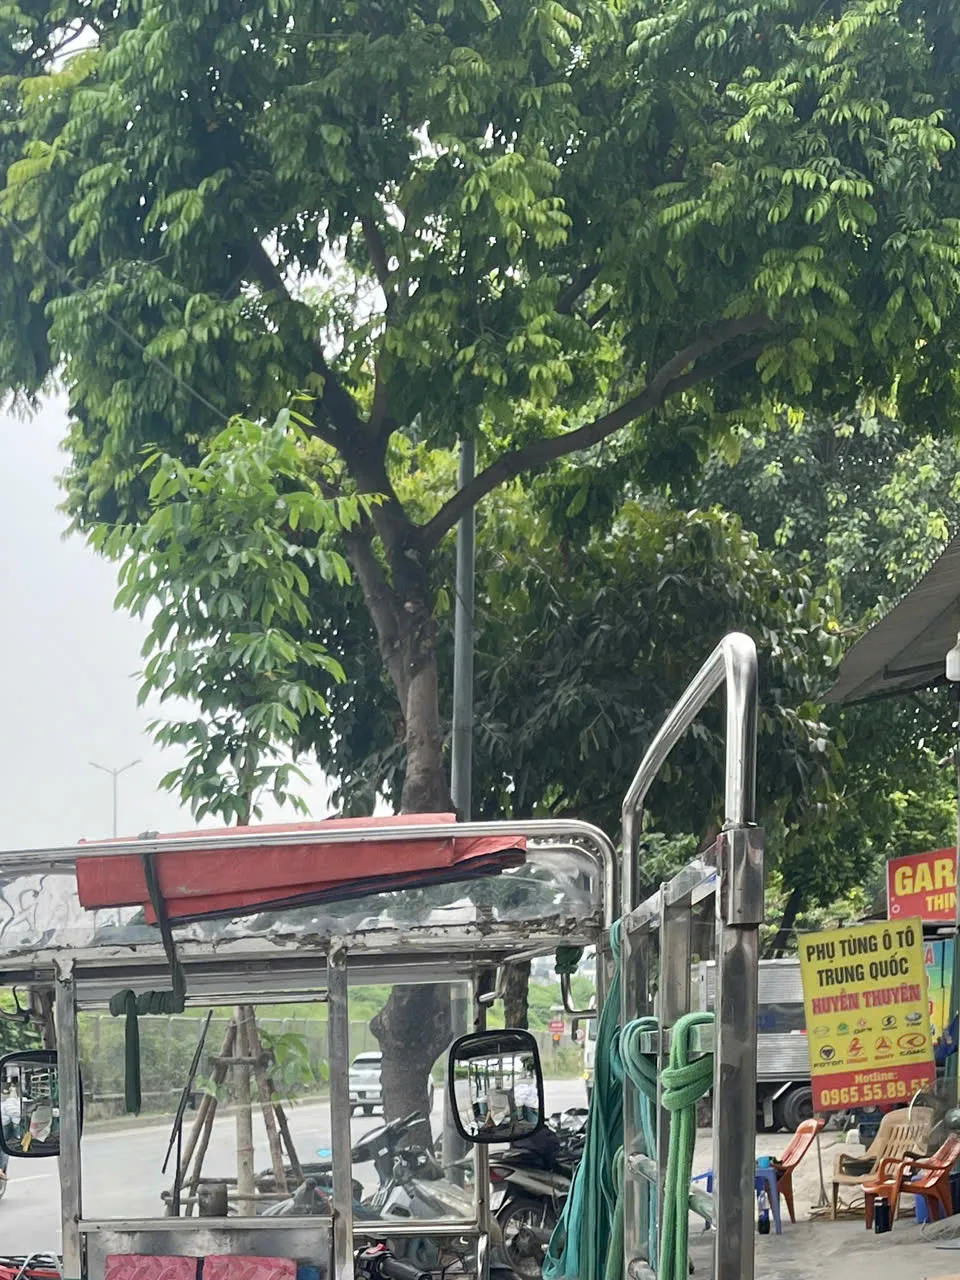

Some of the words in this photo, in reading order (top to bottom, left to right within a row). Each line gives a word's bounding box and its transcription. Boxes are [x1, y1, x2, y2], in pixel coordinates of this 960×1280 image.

[895, 858, 957, 897] GAR
[806, 941, 836, 963] PHỤ
[839, 935, 878, 957] TÙNG
[882, 929, 892, 950] Ô
[896, 925, 915, 949] TÔ
[817, 964, 865, 987] TRUNG
[869, 952, 909, 981] QUỐC
